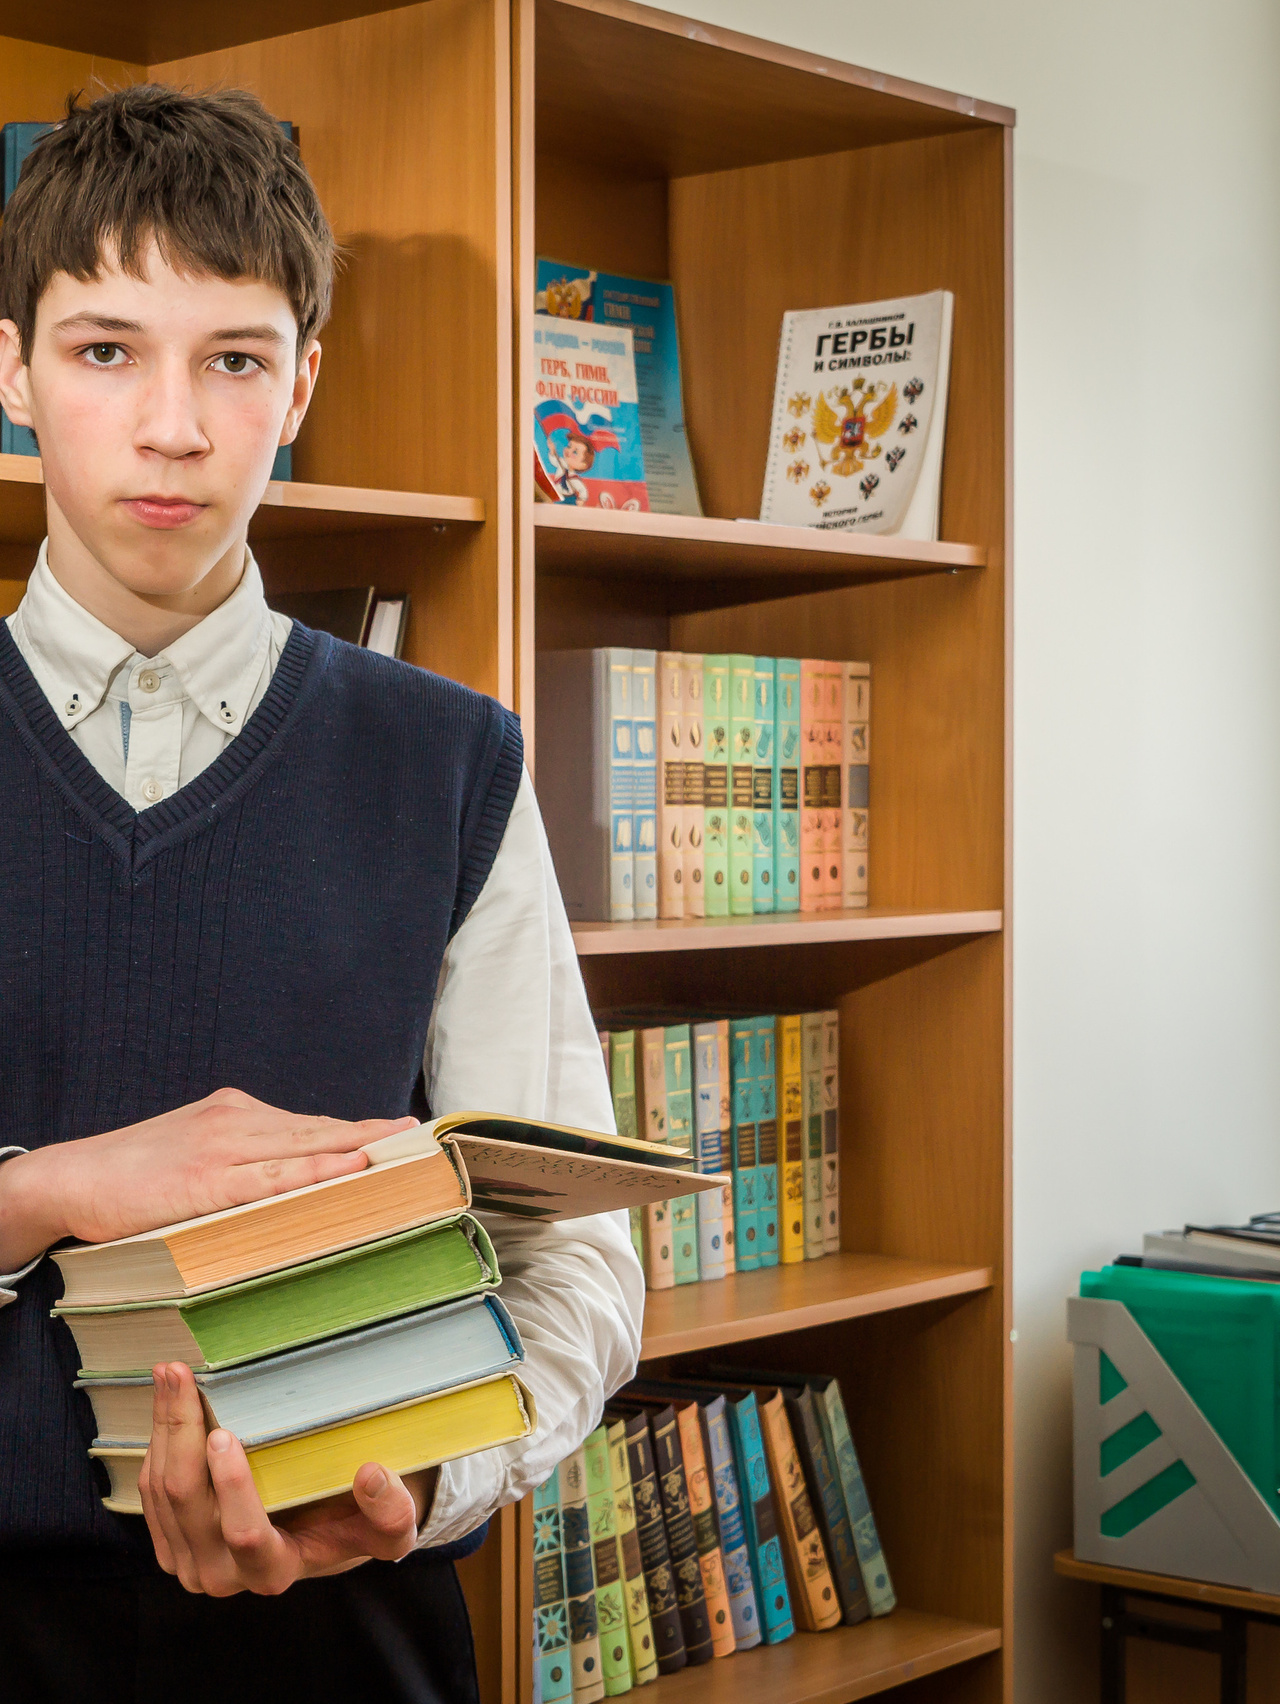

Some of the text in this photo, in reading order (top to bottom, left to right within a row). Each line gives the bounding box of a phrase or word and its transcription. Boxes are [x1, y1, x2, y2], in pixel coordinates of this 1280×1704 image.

[816, 322, 914, 357] ГЕРБЫ
[813, 361, 824, 372] И
[535, 379, 619, 407] ФЛАГ РОССИИ
